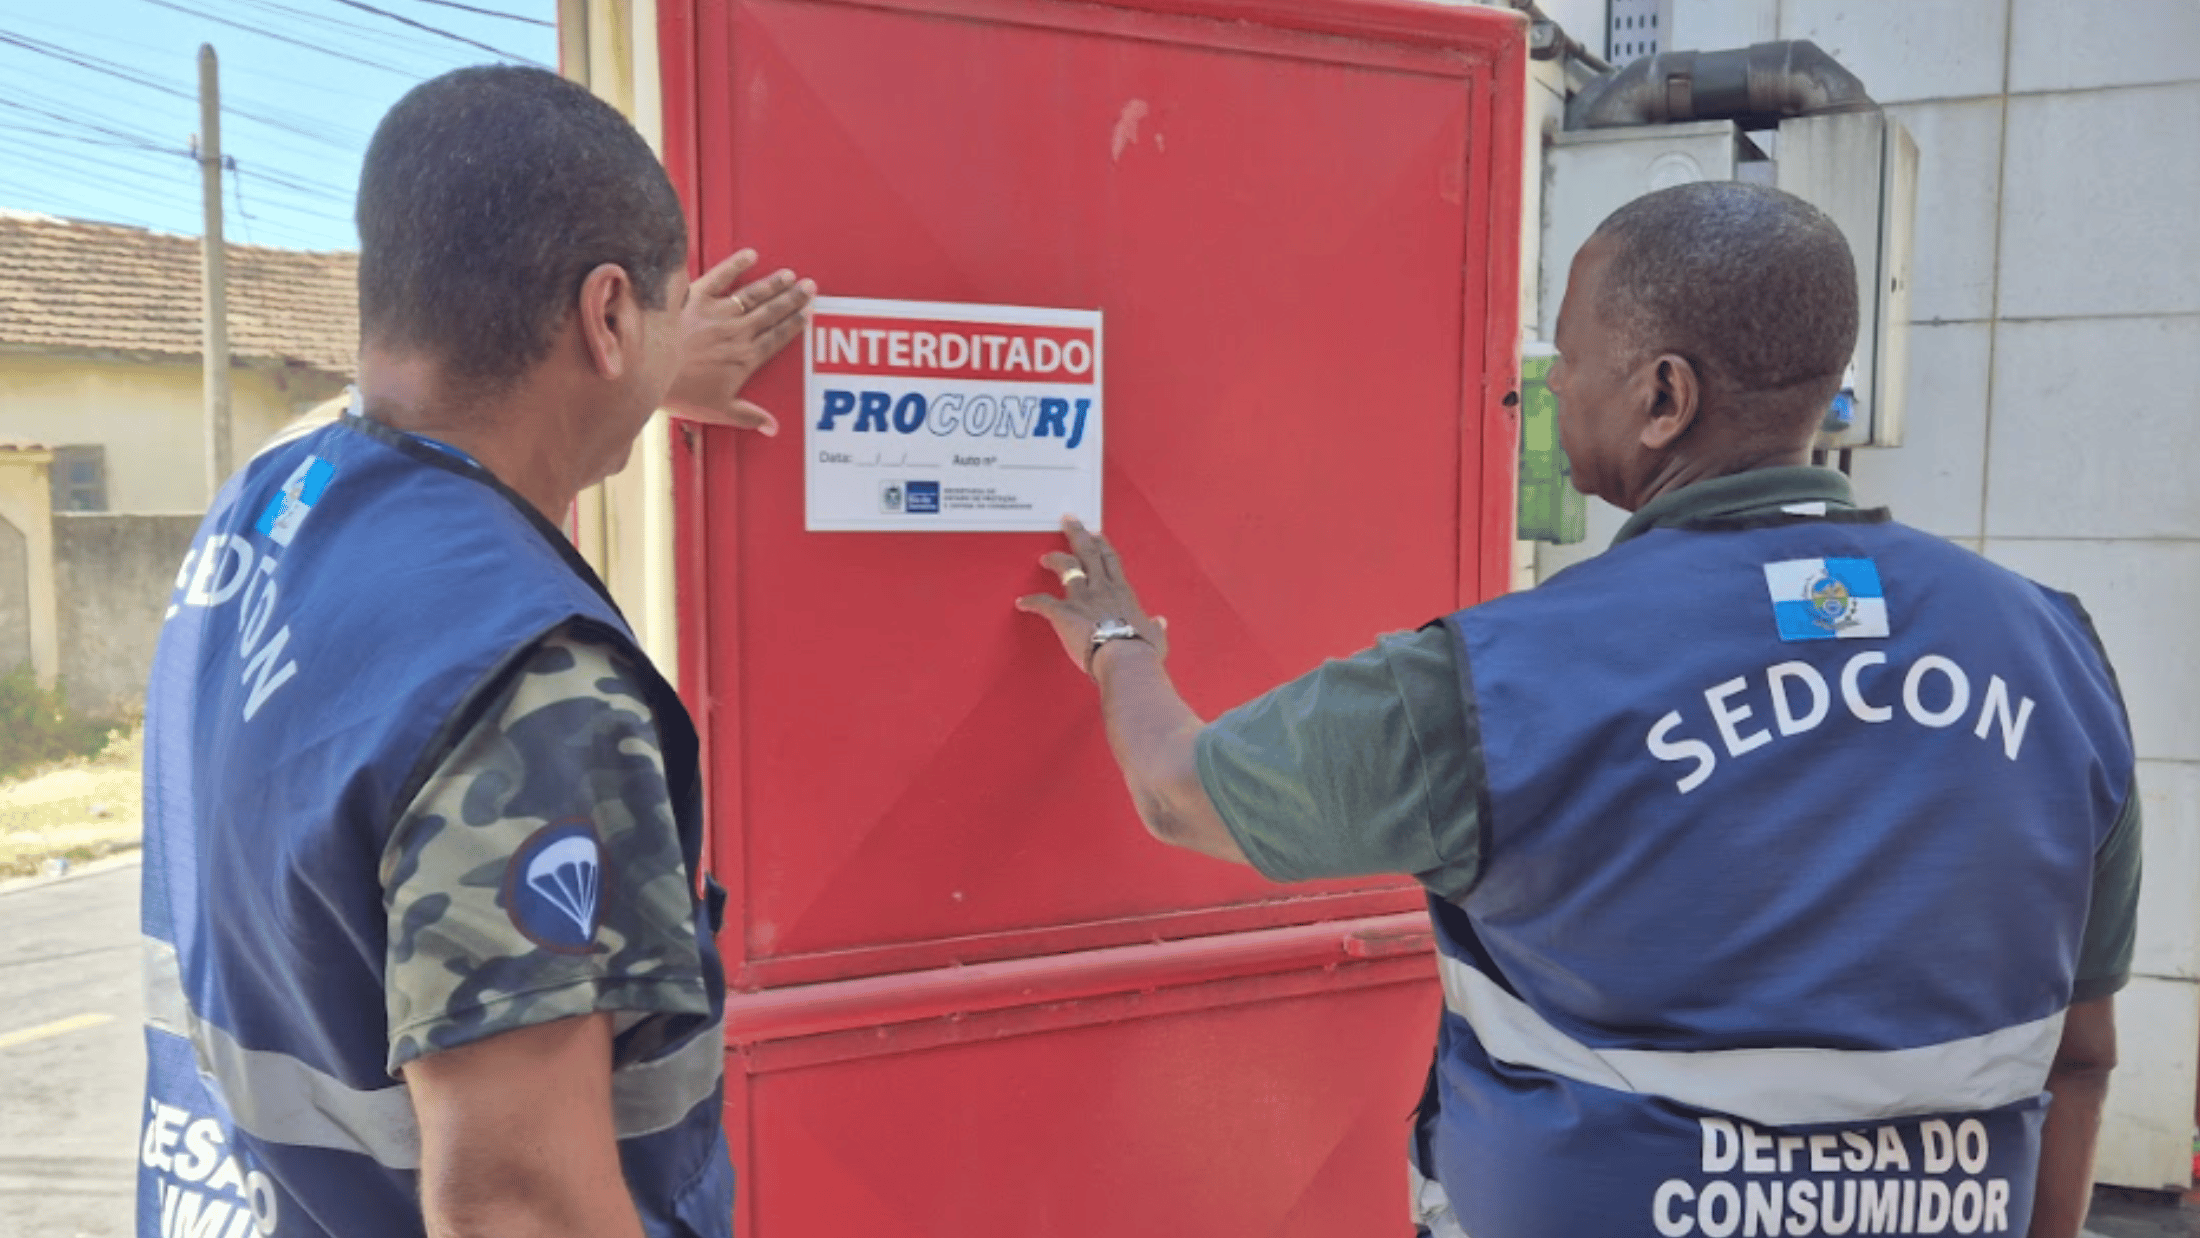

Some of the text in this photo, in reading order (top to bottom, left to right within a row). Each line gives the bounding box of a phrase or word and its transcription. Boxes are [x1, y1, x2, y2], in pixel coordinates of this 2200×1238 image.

[815, 327, 1093, 375] INTERDITADO
[819, 450, 853, 464] Data:
[952, 453, 981, 467] Auto
[1646, 651, 2036, 795] SEDCON
[1921, 1118, 1989, 1175] DO
[1653, 1178, 2010, 1238] CONSUMIDOR
